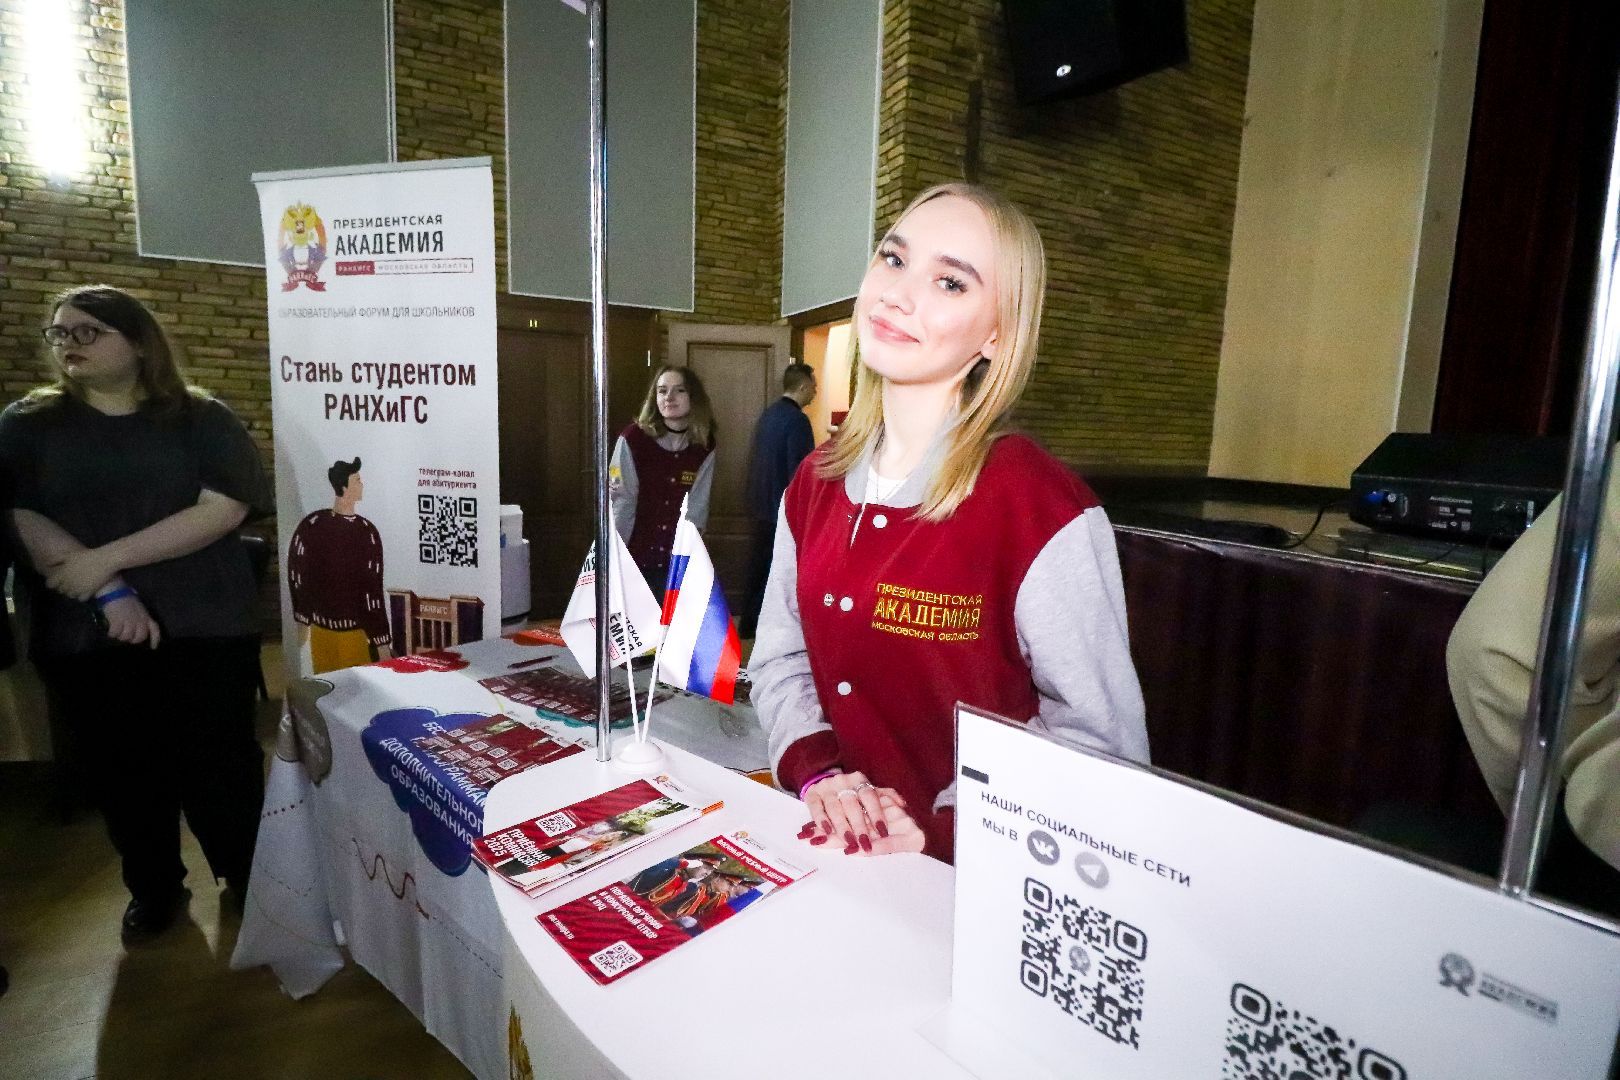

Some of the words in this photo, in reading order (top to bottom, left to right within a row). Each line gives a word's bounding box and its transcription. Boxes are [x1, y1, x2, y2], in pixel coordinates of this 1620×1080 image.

[333, 214, 443, 229] ПРЕЗИДЕНТСКАЯ
[335, 230, 444, 256] АКАДЕМИЯ
[359, 306, 390, 317] ФОРУМ
[392, 306, 410, 318] ДЛЯ
[412, 306, 475, 317] ШКОЛЬНИКОВ
[280, 355, 343, 383] Стань
[351, 362, 476, 390] студентом
[324, 393, 428, 424] РАНХиГС
[417, 479, 431, 488] для
[432, 479, 477, 490] абитуриента
[418, 467, 475, 479] телеграм-канал
[877, 583, 983, 606] ПРЕЗИДЕНТСКАЯ
[874, 597, 981, 628] АКАДЕМИЯ
[871, 621, 934, 640] МОСКОВСКАЯ
[938, 631, 979, 641] ОБЛАСТЬ
[380, 738, 484, 832] ДОПОЛНИТЕЛЬНОГ
[391, 764, 474, 847] ОБРАЗОВАНИЯ
[981, 791, 1022, 816] НАШИ
[1027, 809, 1138, 866] СОЦИАЛЬНЫЕ
[1143, 859, 1191, 888] СЕТИ
[982, 818, 1005, 836] МЫ
[1009, 828, 1018, 842] В
[484, 837, 507, 857] 2025
